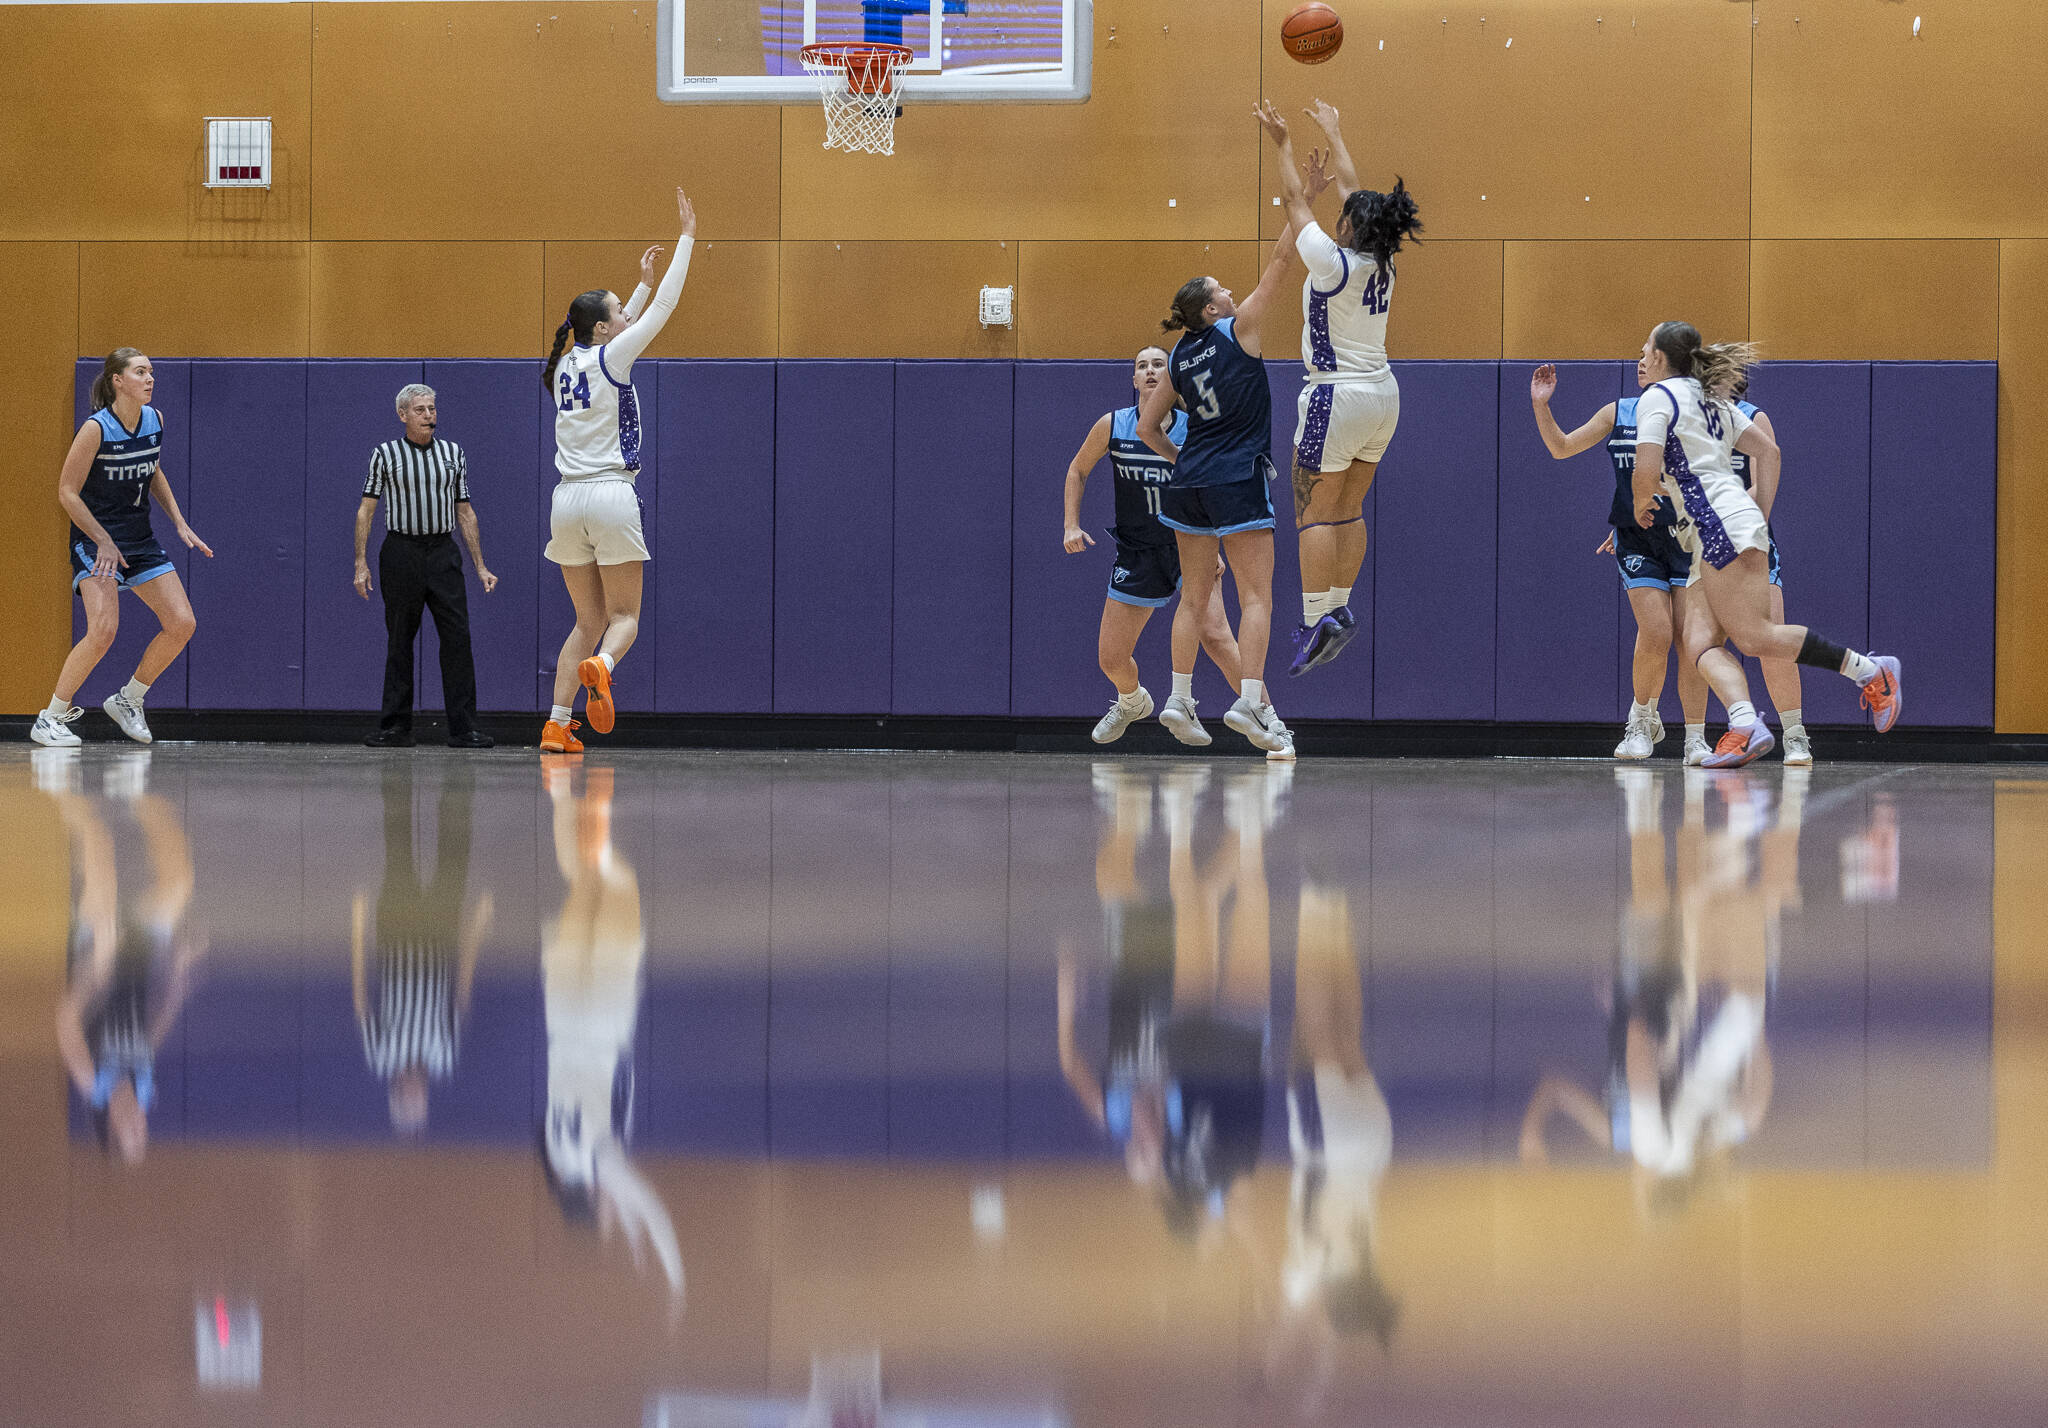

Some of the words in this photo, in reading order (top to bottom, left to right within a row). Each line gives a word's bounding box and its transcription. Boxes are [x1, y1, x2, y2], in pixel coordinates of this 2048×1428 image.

[1362, 272, 1390, 316] 42
[1178, 344, 1217, 372] BURKE
[559, 371, 592, 411] 24
[1192, 368, 1221, 421] 5
[104, 459, 160, 481] TITAN
[1144, 486, 1161, 516] 11
